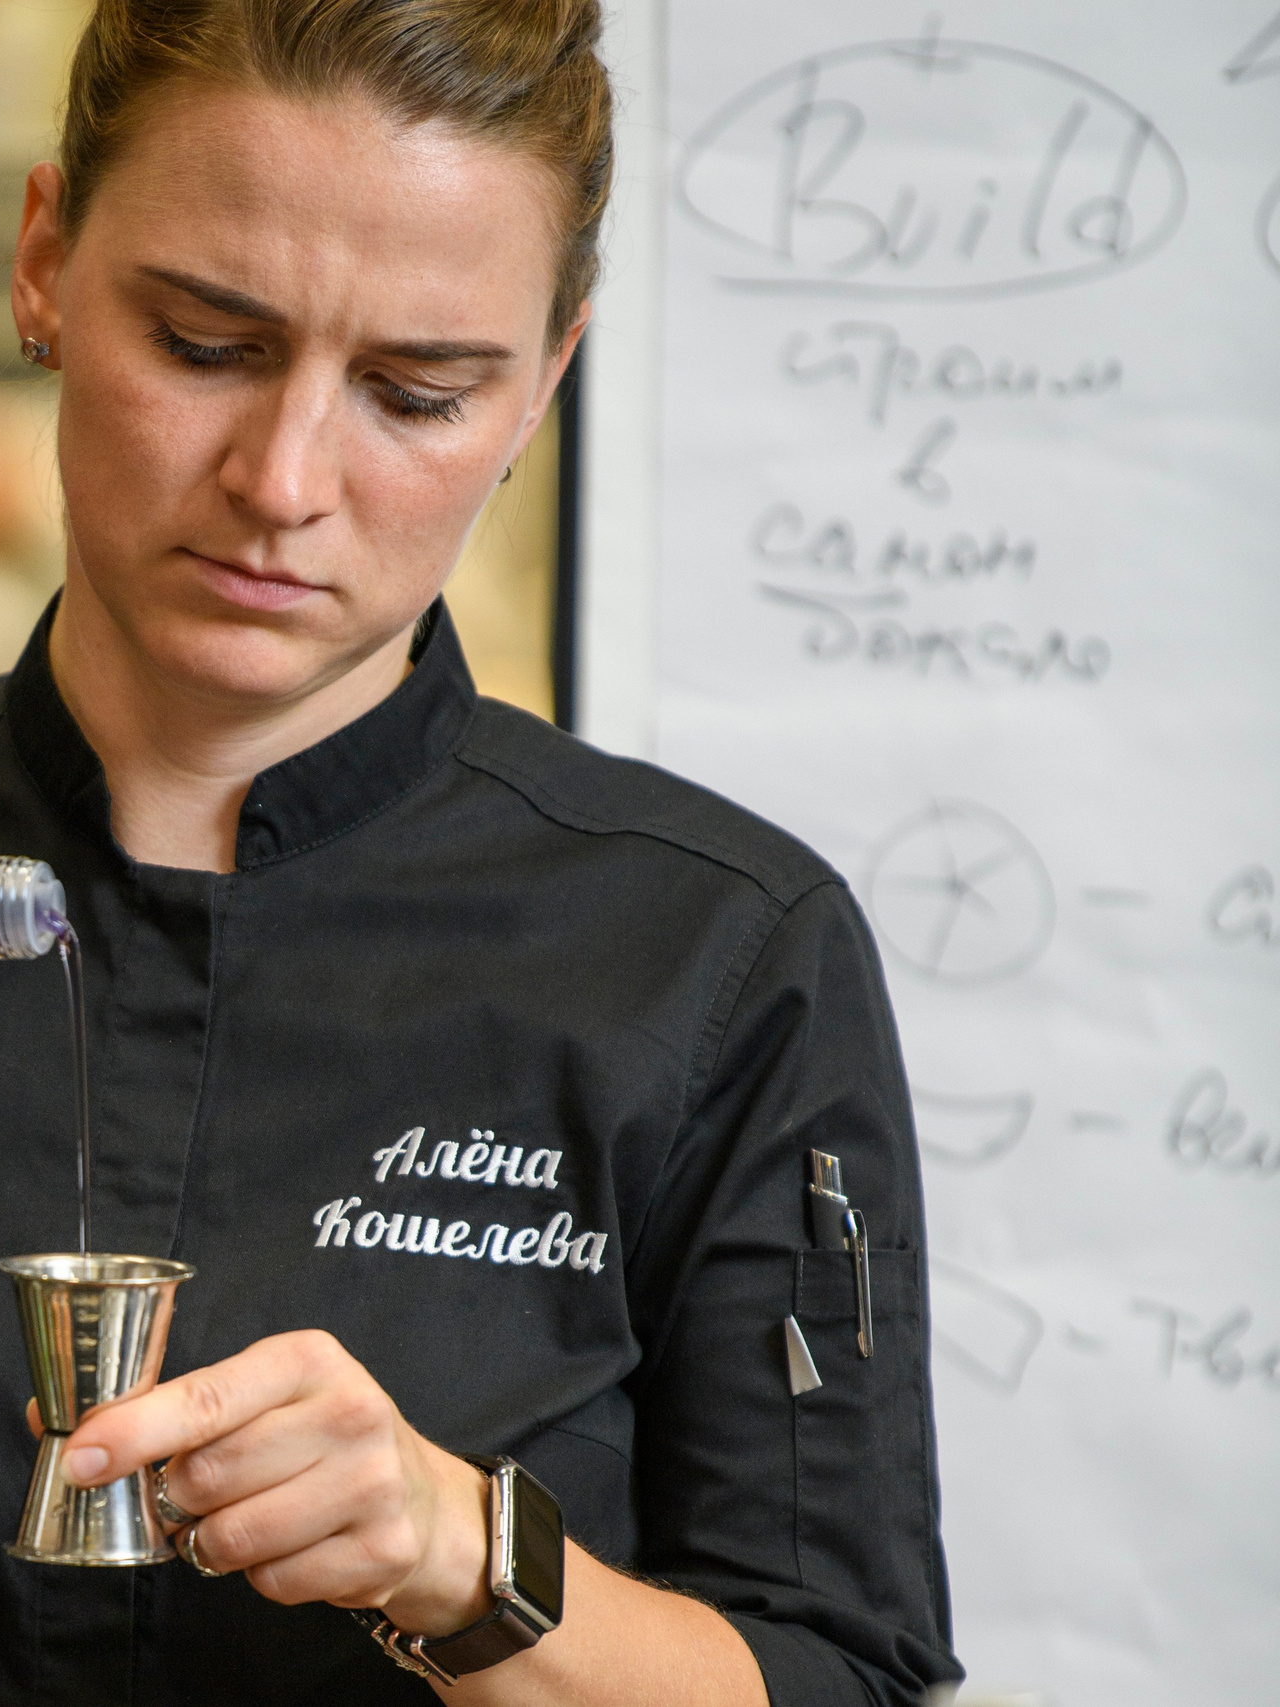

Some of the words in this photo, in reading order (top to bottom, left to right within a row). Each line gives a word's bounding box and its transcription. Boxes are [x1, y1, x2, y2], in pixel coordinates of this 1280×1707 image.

[773, 62, 1156, 276] Build
[373, 1126, 563, 1190] Алёна
[313, 1196, 609, 1274] Кошелева
